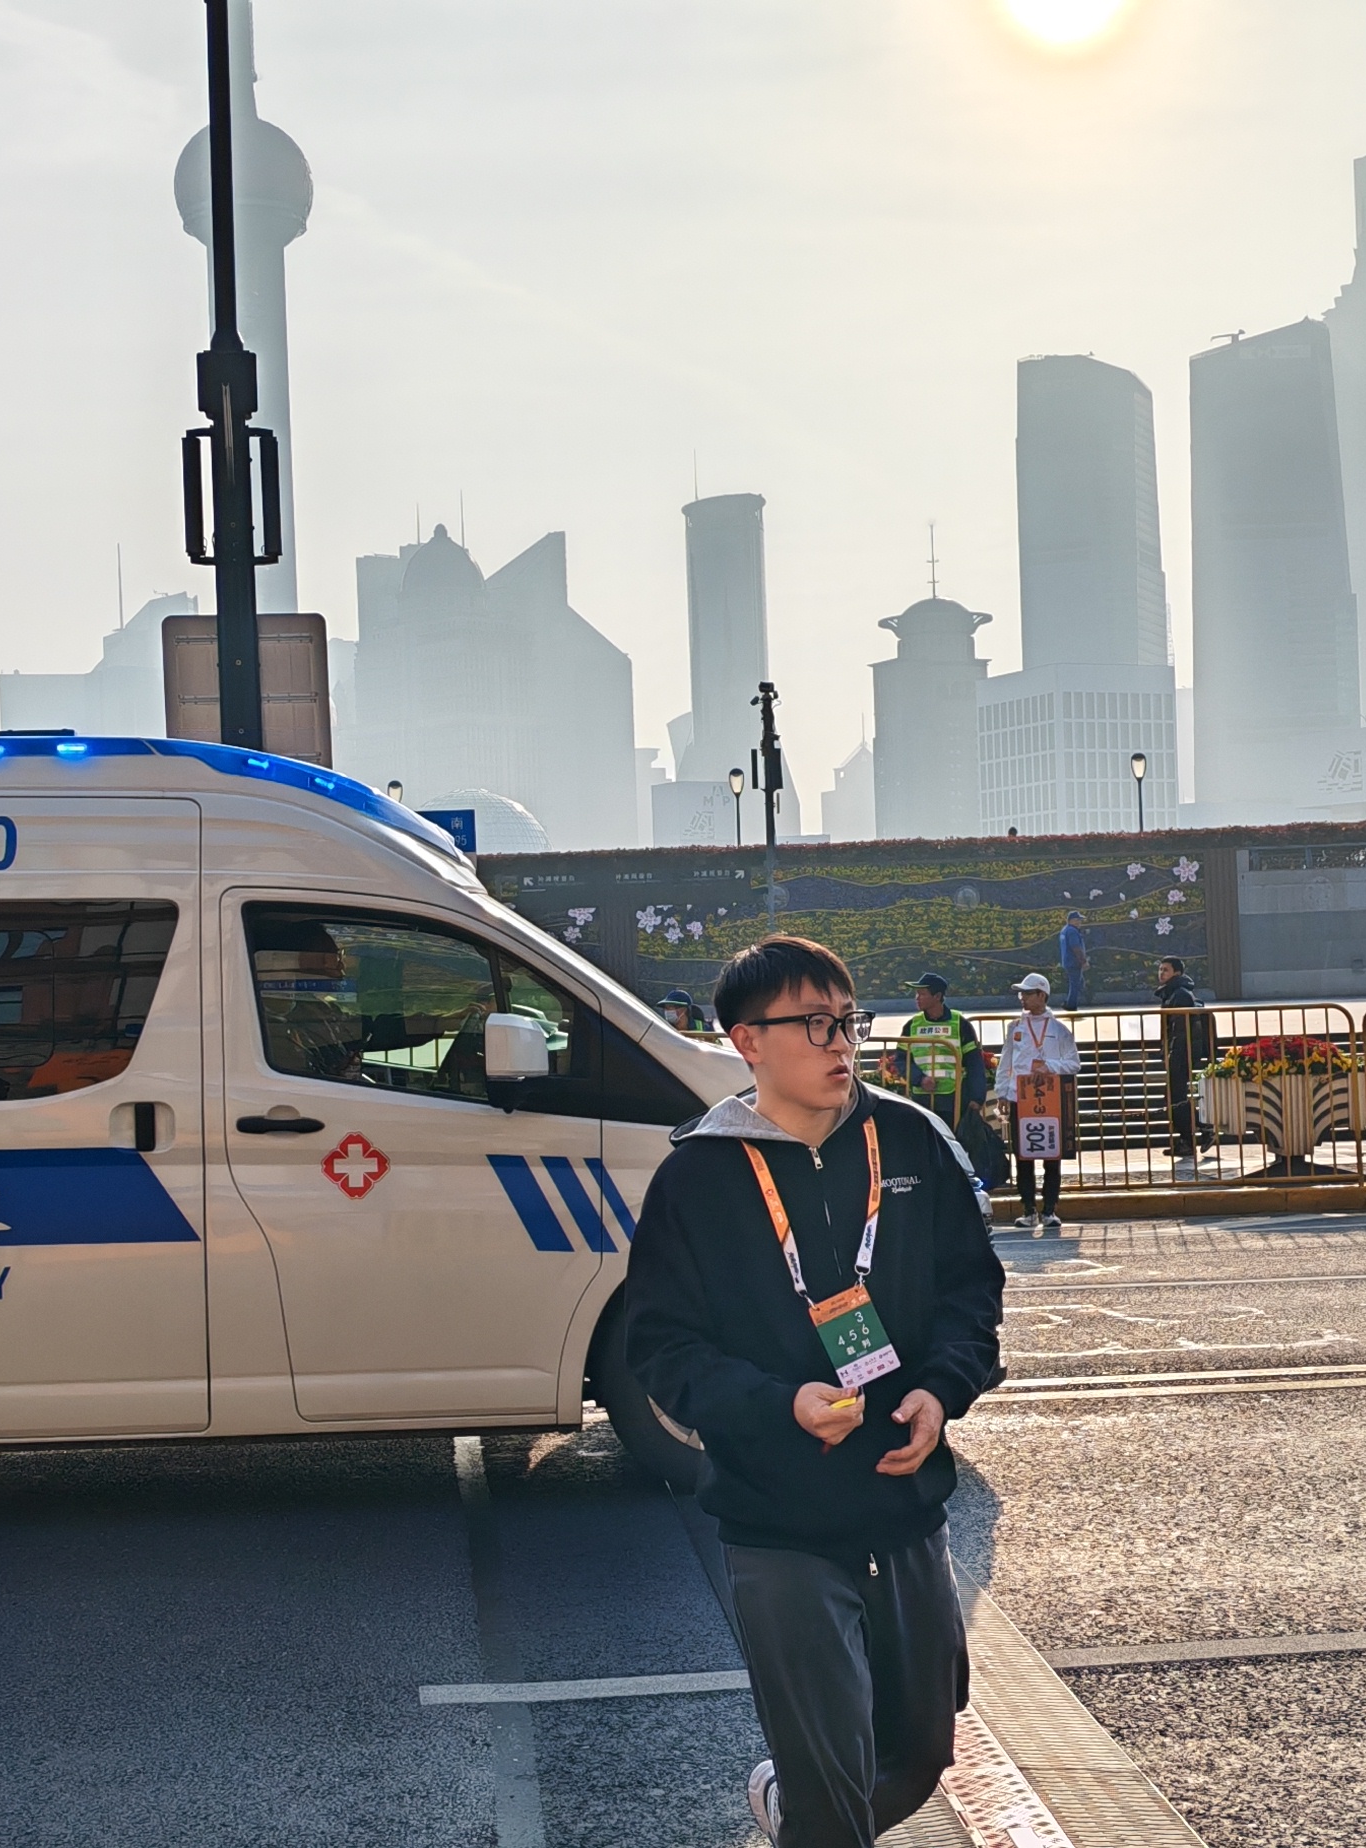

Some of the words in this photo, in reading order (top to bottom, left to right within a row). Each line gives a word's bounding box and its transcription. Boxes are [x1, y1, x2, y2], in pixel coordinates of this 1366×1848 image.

[451, 817, 463, 829] 南
[1026, 1123, 1045, 1153] 304
[855, 1311, 864, 1323] 3
